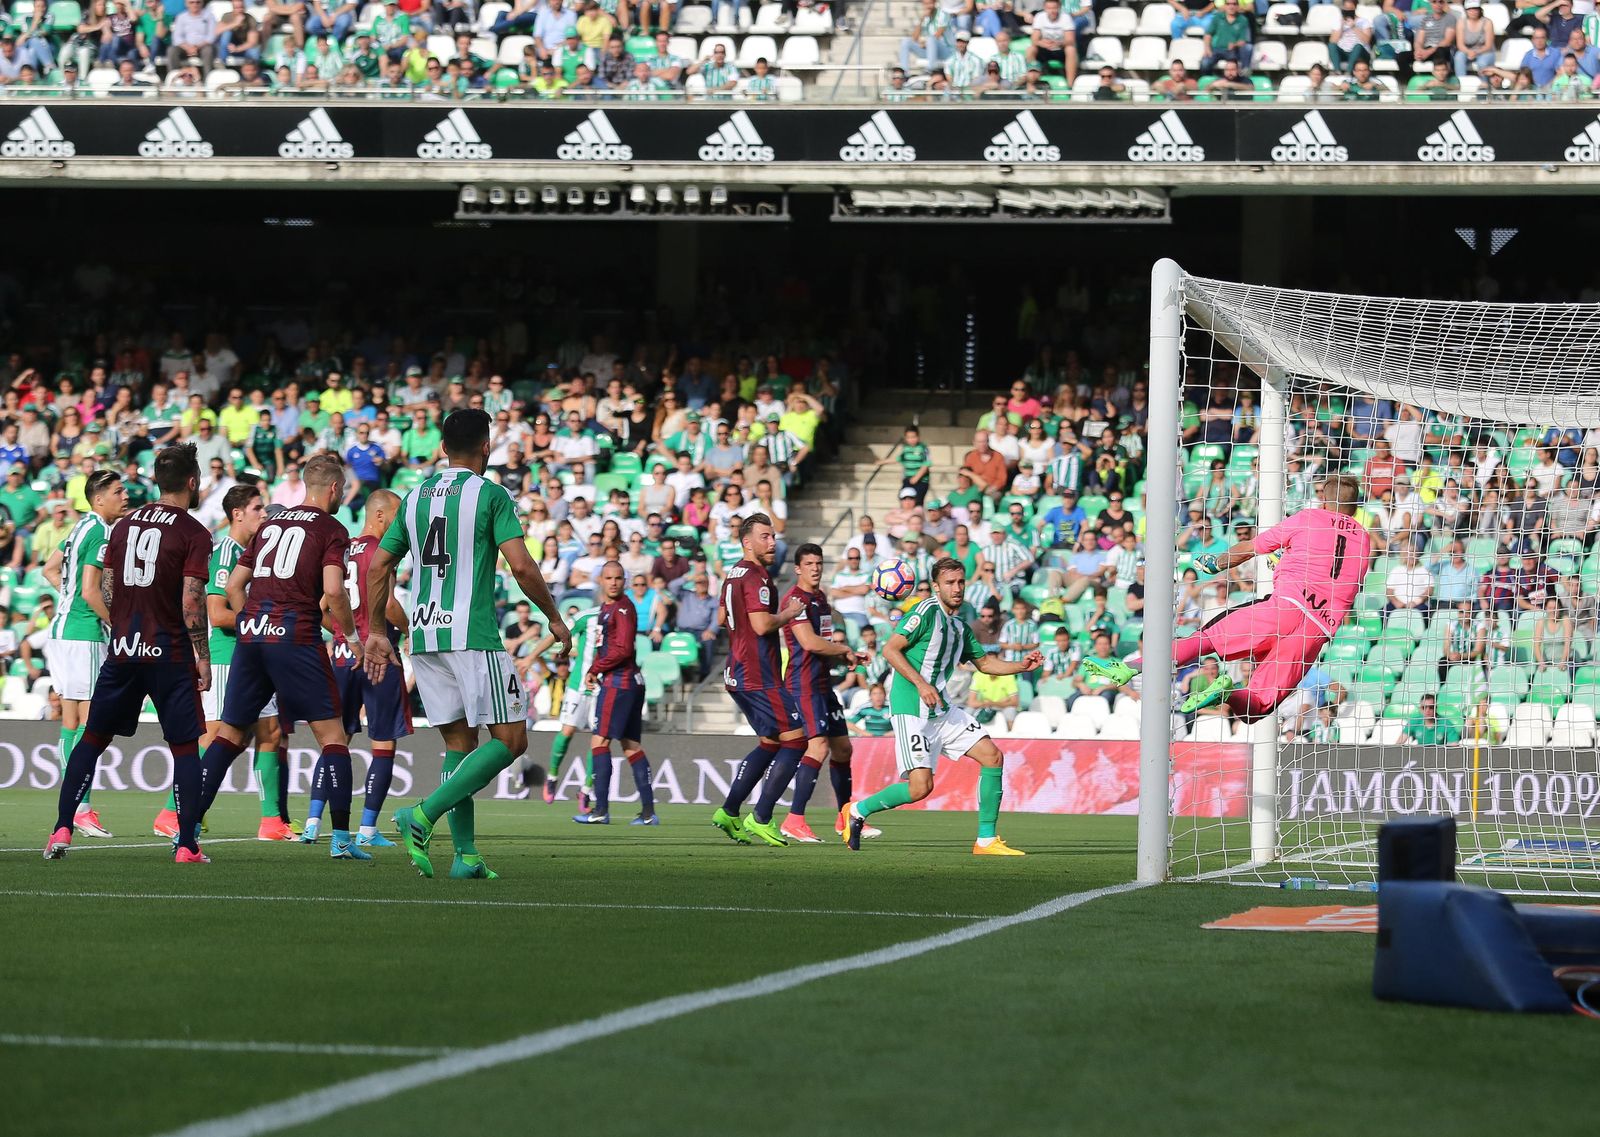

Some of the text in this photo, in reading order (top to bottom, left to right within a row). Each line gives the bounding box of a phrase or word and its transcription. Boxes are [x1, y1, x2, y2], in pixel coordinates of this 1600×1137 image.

[1, 139, 75, 157] adidas
[138, 140, 213, 158] adidas
[278, 141, 354, 159] adidas
[416, 141, 492, 159] adidas
[556, 142, 632, 161] adidas
[698, 143, 774, 162] adidas
[839, 143, 915, 162] adidas
[983, 143, 1060, 162] adidas
[1127, 143, 1204, 162] adidas
[1270, 143, 1347, 162] adidas
[1417, 143, 1495, 162] adidas
[1564, 143, 1600, 162] adi
[420, 485, 460, 498] BRUNO
[1331, 518, 1358, 536] YOEL
[123, 526, 162, 587] 19
[253, 524, 306, 579] 20
[421, 515, 452, 579] 4
[1330, 534, 1347, 580] 1
[413, 601, 453, 627] Wiko
[1303, 588, 1336, 627] Wiko
[239, 614, 286, 636] Wiko
[113, 632, 162, 657] Wiko
[507, 673, 520, 699] 4
[1288, 761, 1465, 819] JAMÓN
